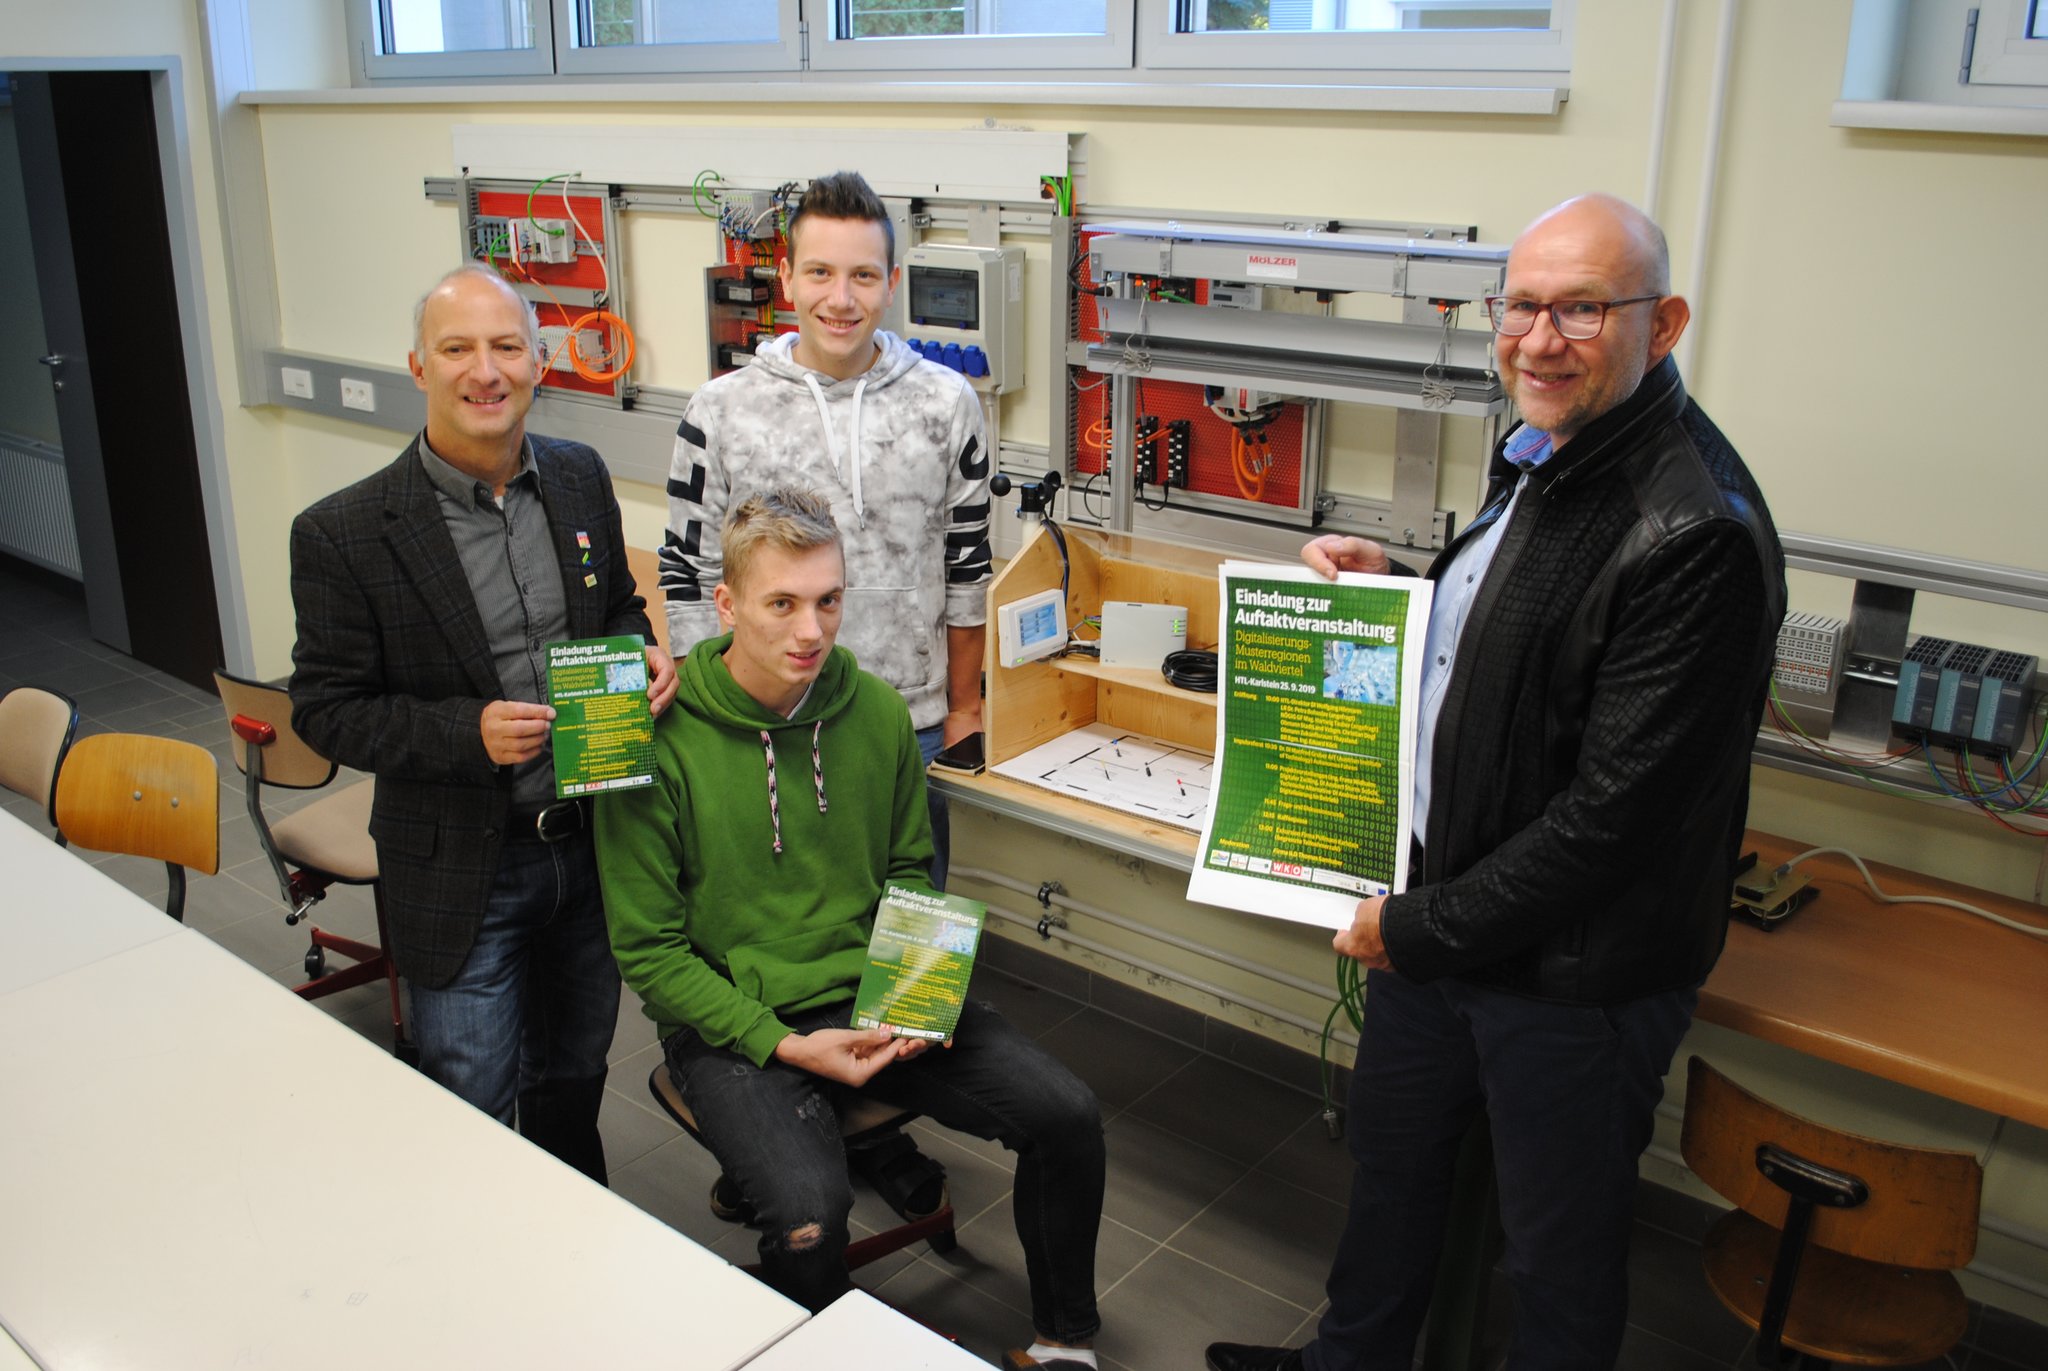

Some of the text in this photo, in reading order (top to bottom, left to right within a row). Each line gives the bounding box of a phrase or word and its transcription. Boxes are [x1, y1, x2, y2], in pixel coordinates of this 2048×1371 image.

[1236, 589, 1331, 613] Einladung zur
[1235, 609, 1396, 643] Auftaktveranstaltung
[1236, 630, 1312, 650] Digitalisierungs-
[551, 646, 593, 657] Einladung
[551, 652, 642, 667] Auftaktveranstaltung
[1236, 645, 1311, 663] Musterregionen
[1235, 660, 1303, 677] im Waldviertel
[1235, 676, 1316, 694] HTL-Karlstein 25. 9. 2019
[1273, 862, 1300, 875] WKO
[888, 886, 947, 906] Einladung zur
[886, 896, 979, 927] Auftaktveranstaltung
